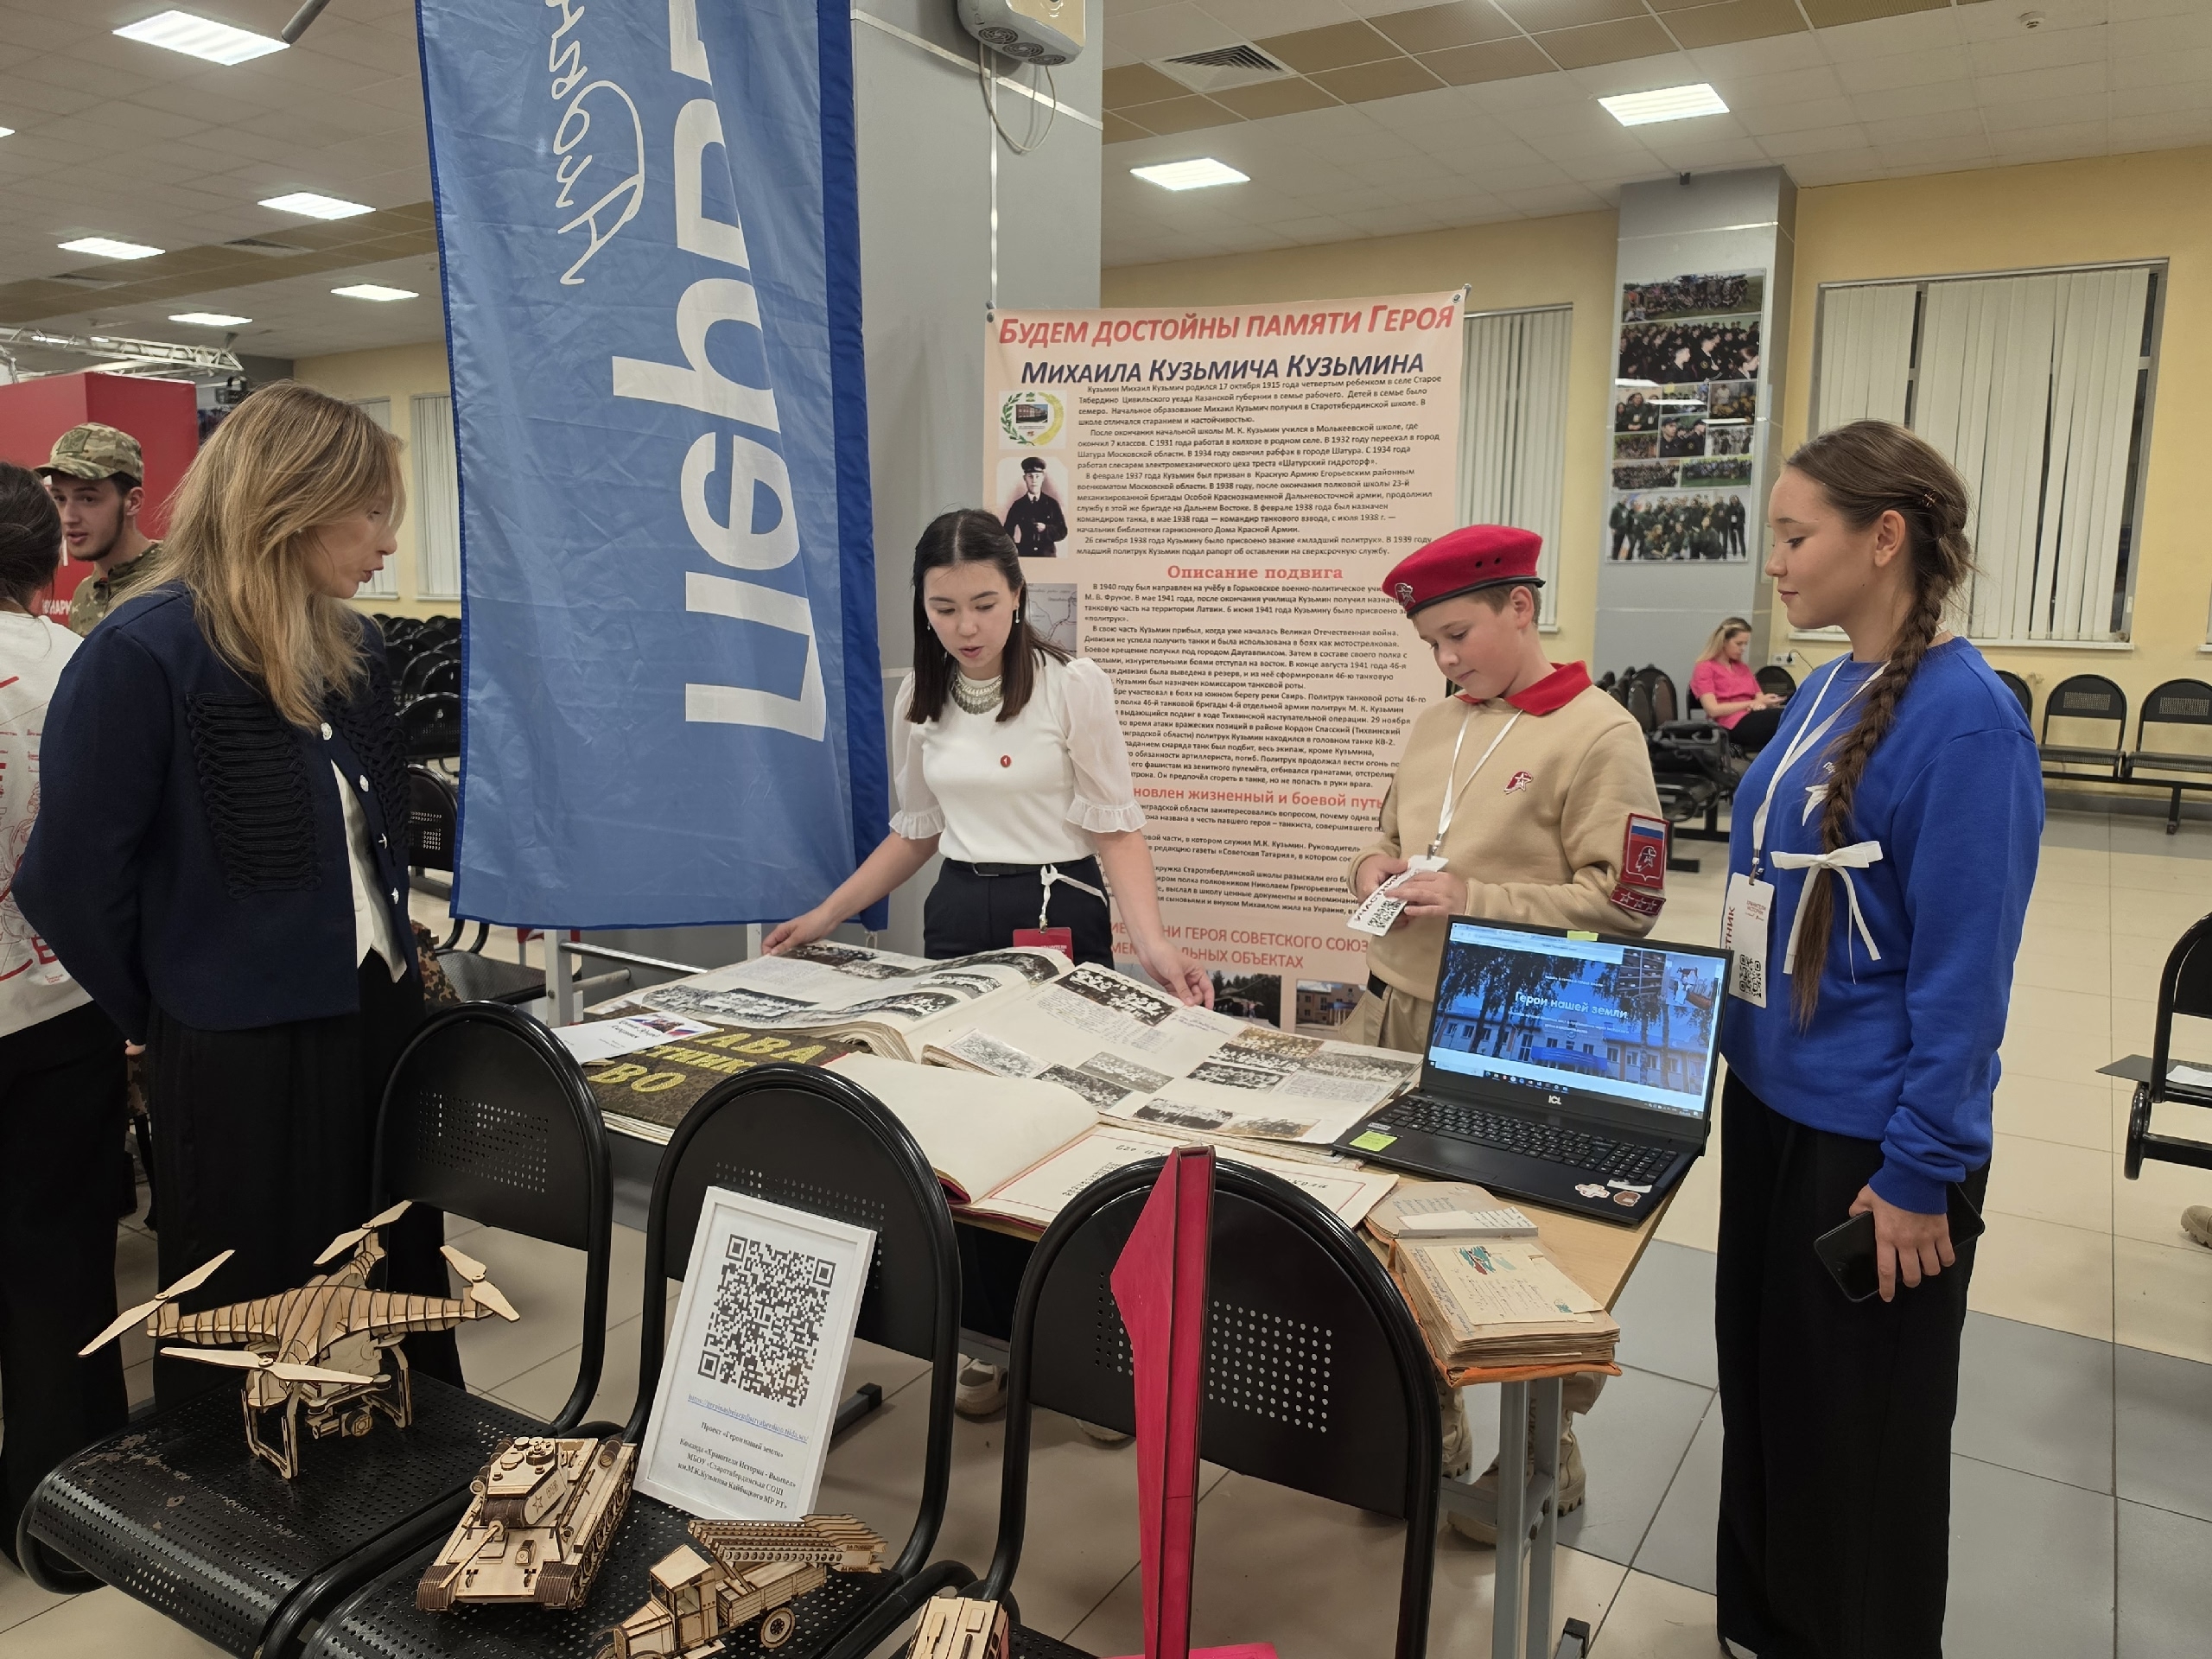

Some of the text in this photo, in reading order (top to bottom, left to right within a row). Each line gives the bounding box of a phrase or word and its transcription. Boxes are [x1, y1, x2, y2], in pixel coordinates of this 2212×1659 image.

[1086, 384, 1120, 395] Кузьмин
[1120, 383, 1151, 392] Михаил
[1151, 382, 1185, 393] Кузьмич
[1185, 384, 1217, 392] родился
[1218, 381, 1228, 390] 17
[1229, 380, 1261, 391] октября
[1262, 379, 1281, 389] 1915
[1300, 379, 1344, 389] четвертым
[1344, 376, 1386, 388] ребенком
[1413, 373, 1441, 385] Старое
[1078, 394, 1119, 406] Тябердино
[1121, 393, 1171, 403] Цивильского
[1171, 395, 1193, 404] уезда
[1194, 391, 1235, 401] Казанской
[1235, 391, 1272, 403] губернии
[1346, 388, 1372, 398] Детей
[1405, 385, 1427, 395] было
[1110, 404, 1152, 414] Начальное
[1153, 404, 1202, 415] образование
[1203, 403, 1234, 412] Михаил
[1234, 402, 1268, 413] Кузьмич
[1269, 404, 1303, 413] получил
[1141, 418, 1183, 427] старанием
[1077, 460, 1108, 471] работал
[1108, 462, 1144, 471] слесарем
[1251, 461, 1276, 469] треста
[1277, 457, 1325, 469] «Шатурский
[1149, 492, 1183, 503] бригады
[1183, 492, 1212, 500] Особой
[1385, 492, 1433, 501] продолжил
[1116, 524, 1161, 532] библиотеки
[1213, 524, 1236, 534] Дома
[1236, 524, 1270, 534] Красной
[1166, 564, 1343, 581] Описание подвига
[1138, 625, 1171, 636] Кузьмин
[1226, 628, 1242, 637] уже
[1279, 626, 1312, 635] Великая
[1084, 644, 1109, 652] Боевое
[1110, 646, 1147, 655] крещение
[1148, 647, 1180, 656] получил
[1196, 648, 1230, 657] городом
[1288, 647, 1312, 657] Затем
[1119, 708, 1168, 718] выдающийся
[1202, 711, 1220, 720] ходе
[1221, 709, 1266, 720] Тихвинской
[1370, 715, 1380, 723] 29
[1381, 715, 1410, 726] ноября
[1122, 727, 1161, 740] нградской
[1162, 729, 1194, 739] области)
[1194, 733, 1230, 742] политрук
[1230, 732, 1264, 743] Кузьмин
[1264, 735, 1305, 744] находился
[1134, 787, 1185, 800] новлен
[1187, 788, 1274, 804] жизненный
[1278, 794, 1287, 804] и
[1291, 791, 1346, 807] боевой
[1725, 906, 1735, 950] ТНИК
[1185, 926, 1228, 942] ГЕРОЯ
[1230, 930, 1322, 950] СОВЕТСКОГО
[1325, 938, 1369, 953] СОЮЗ
[1231, 950, 1304, 969] ОБЪЕКТАХ
[1515, 991, 1548, 1007] Герои
[1550, 998, 1589, 1014] нашей
[1548, 1094, 1562, 1105] ICL
[701, 1421, 722, 1436] Проект
[679, 1438, 704, 1454] Команда
[686, 1452, 706, 1466] МБОУ
[766, 1483, 784, 1497] СОШ
